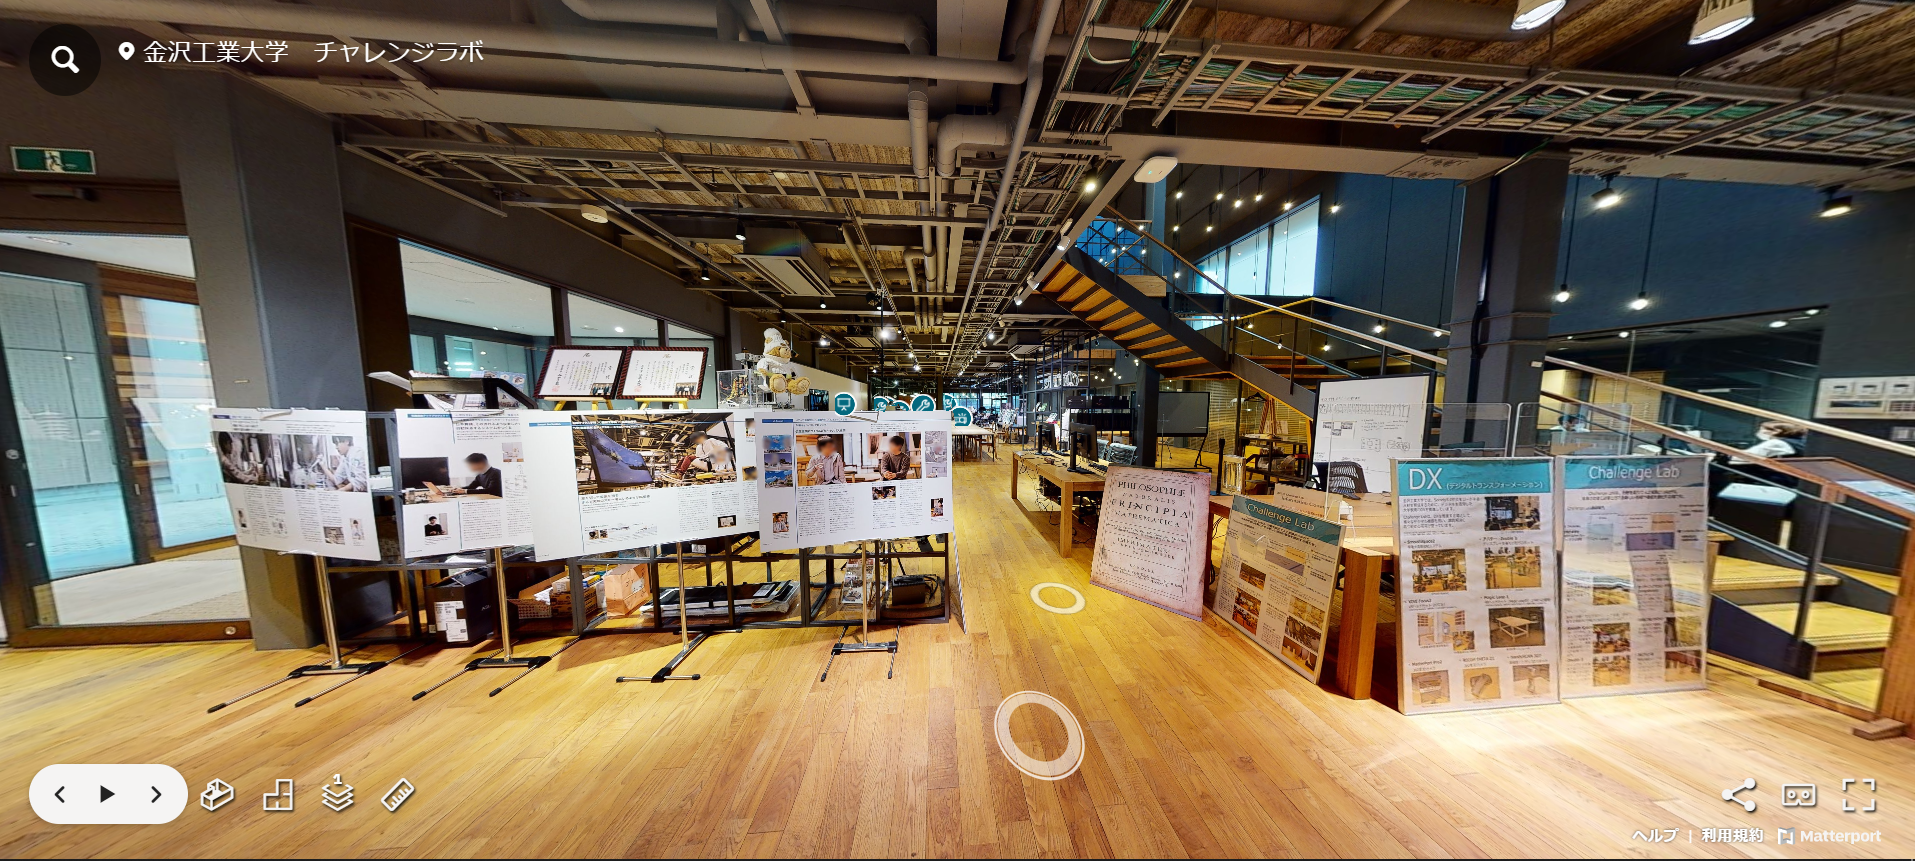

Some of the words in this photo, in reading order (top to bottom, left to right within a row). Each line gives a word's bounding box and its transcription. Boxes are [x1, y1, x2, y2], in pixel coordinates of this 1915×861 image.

[1409, 468, 1443, 490] DX
[1589, 465, 1653, 481] Challenge
[1657, 464, 1680, 478] Lab
[1247, 502, 1292, 525] Challenge
[1294, 517, 1316, 533] Lab
